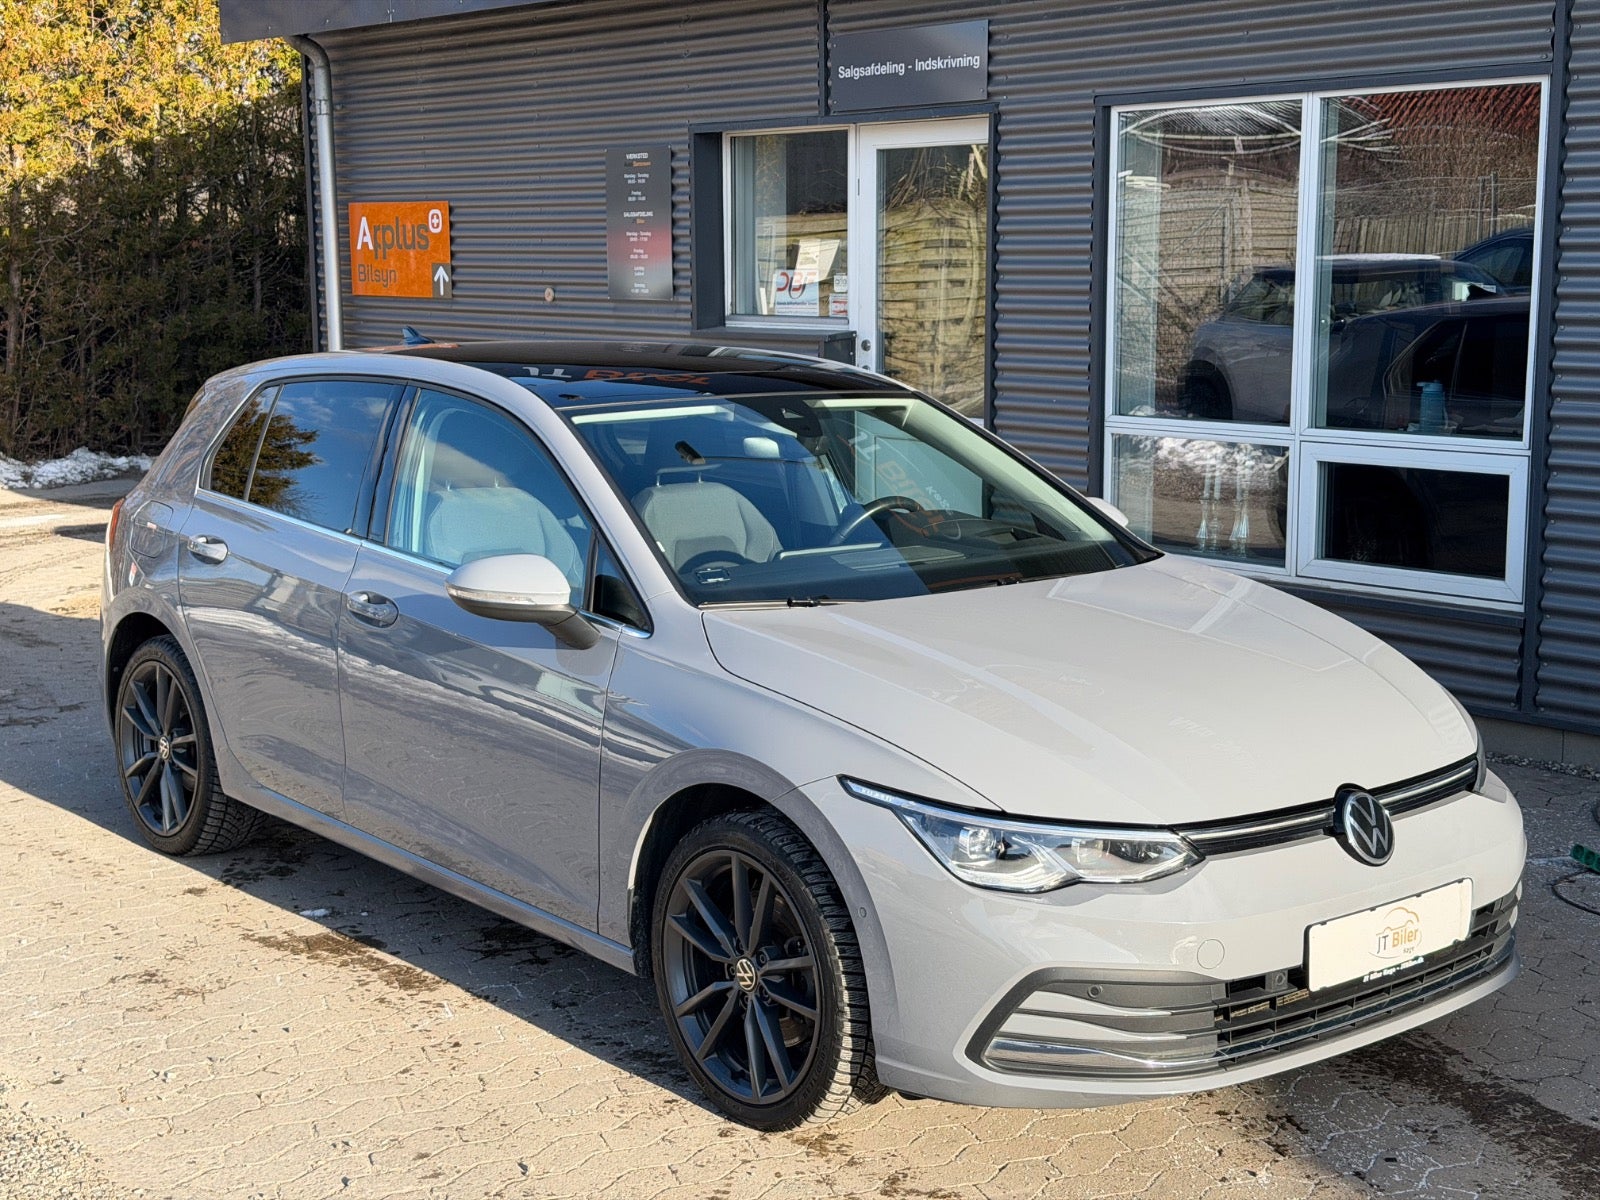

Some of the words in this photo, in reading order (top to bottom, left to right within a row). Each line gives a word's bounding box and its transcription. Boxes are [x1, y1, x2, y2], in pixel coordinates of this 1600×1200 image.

[838, 61, 905, 80] Salgsafdeling
[915, 53, 980, 72] Indskrivning
[358, 264, 397, 288] Bilsyn
[1377, 934, 1389, 954] JT
[1392, 928, 1418, 948] Biler
